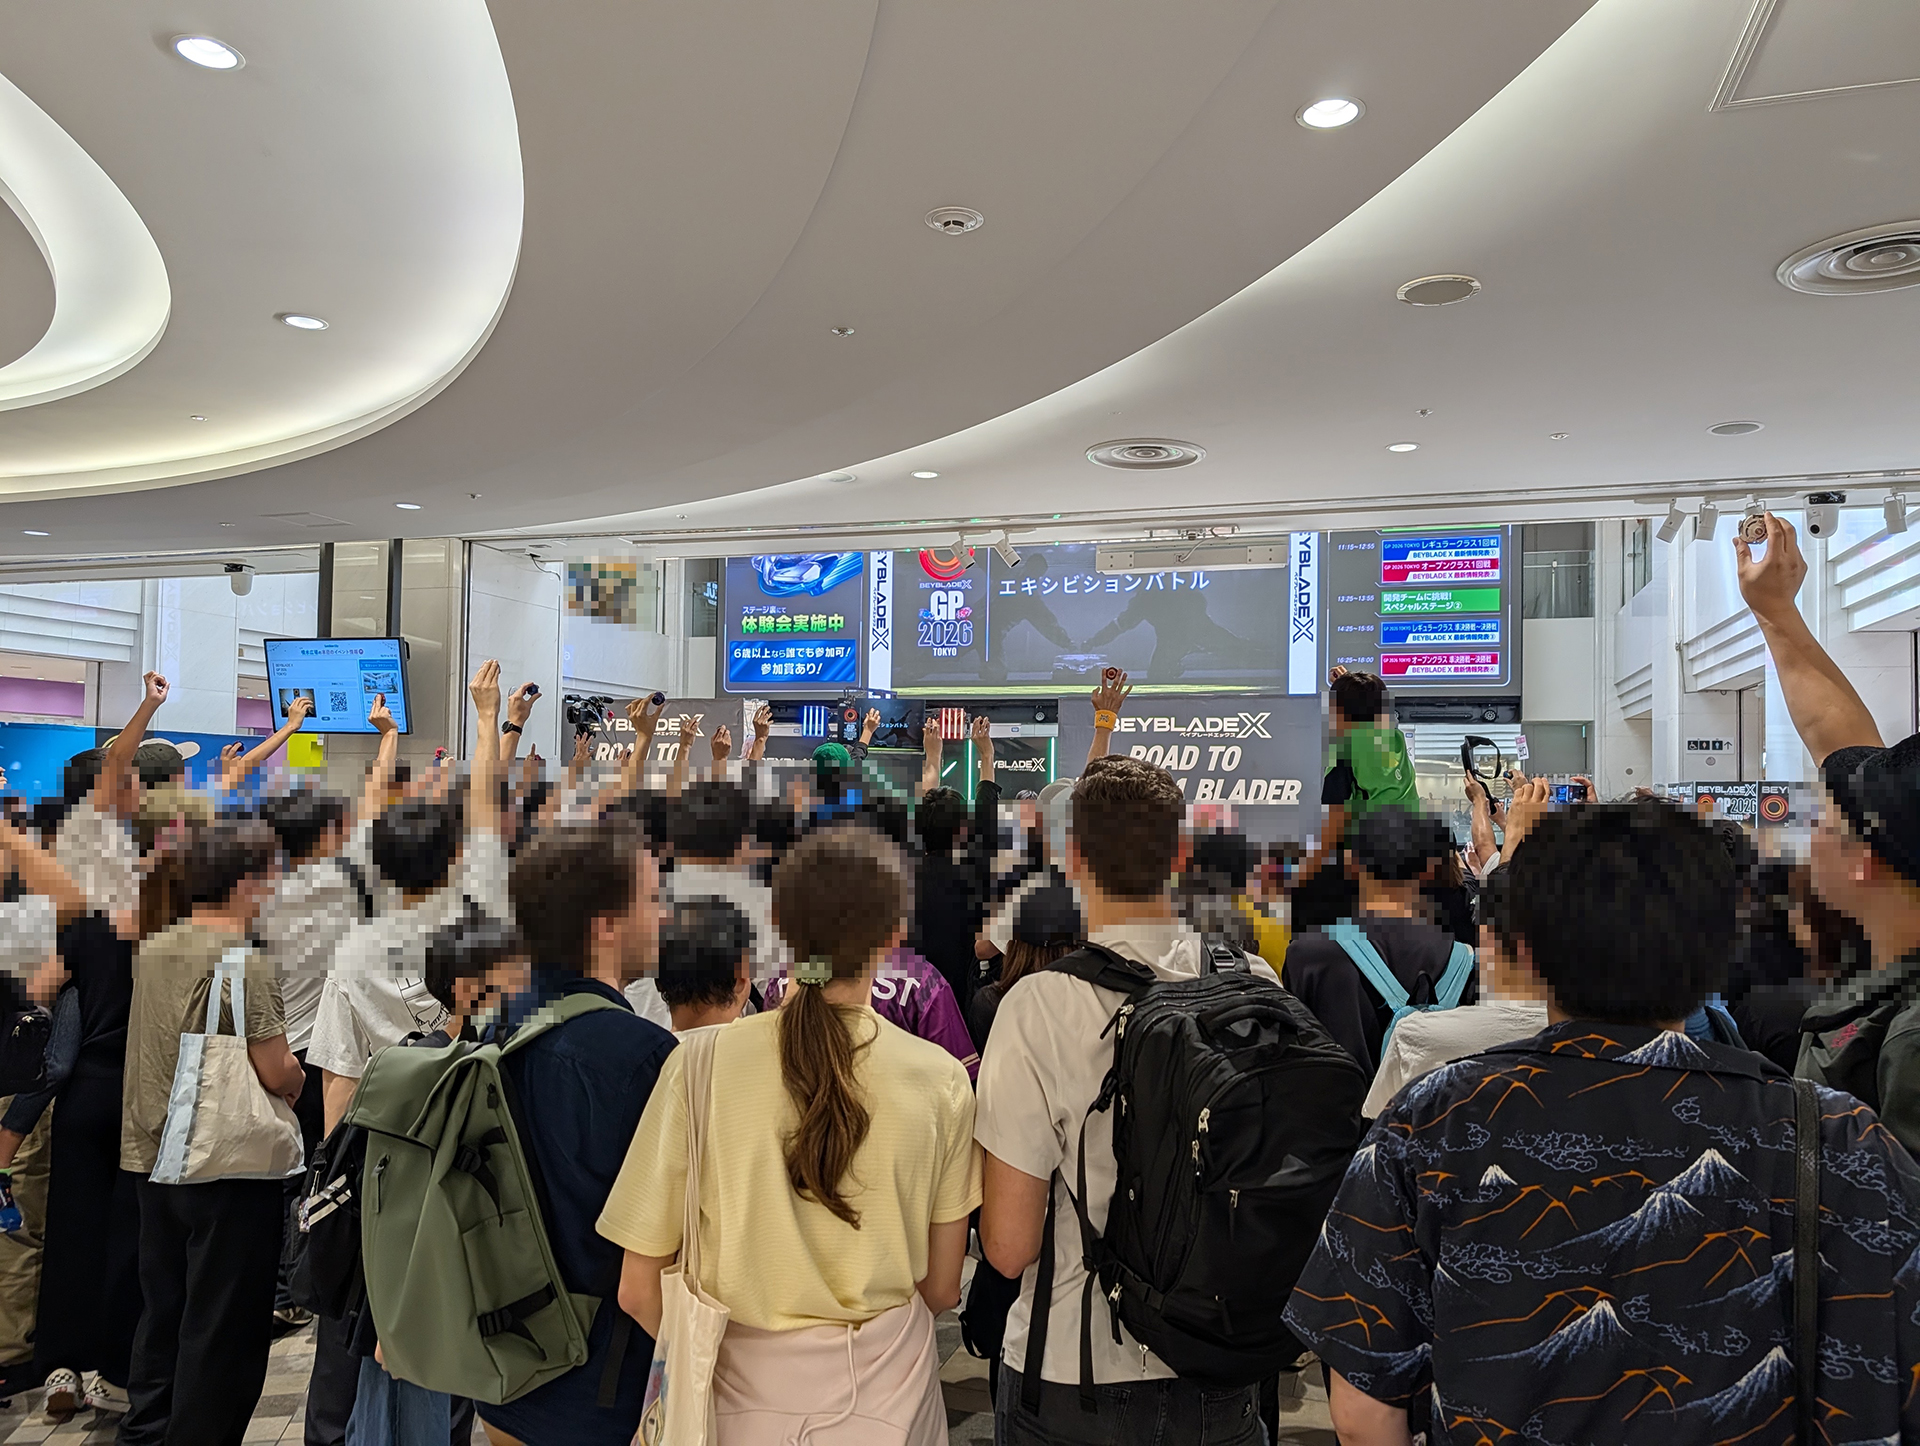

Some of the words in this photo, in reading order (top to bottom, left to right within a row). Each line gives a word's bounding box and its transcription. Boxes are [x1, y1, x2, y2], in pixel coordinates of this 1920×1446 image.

[1000, 572, 1210, 596] エキシビションバトル
[1293, 532, 1314, 644] YBLADEX
[742, 606, 786, 614] ステージ裏にて
[872, 551, 889, 652] YBLADEX
[930, 590, 964, 620] GP
[742, 614, 844, 634] 体験会実施中
[918, 620, 973, 646] 2026
[933, 648, 957, 656] TOKYO
[761, 663, 823, 675] 参加賞あり!
[1208, 745, 1242, 772] TO
[1195, 779, 1302, 802] BLADER
